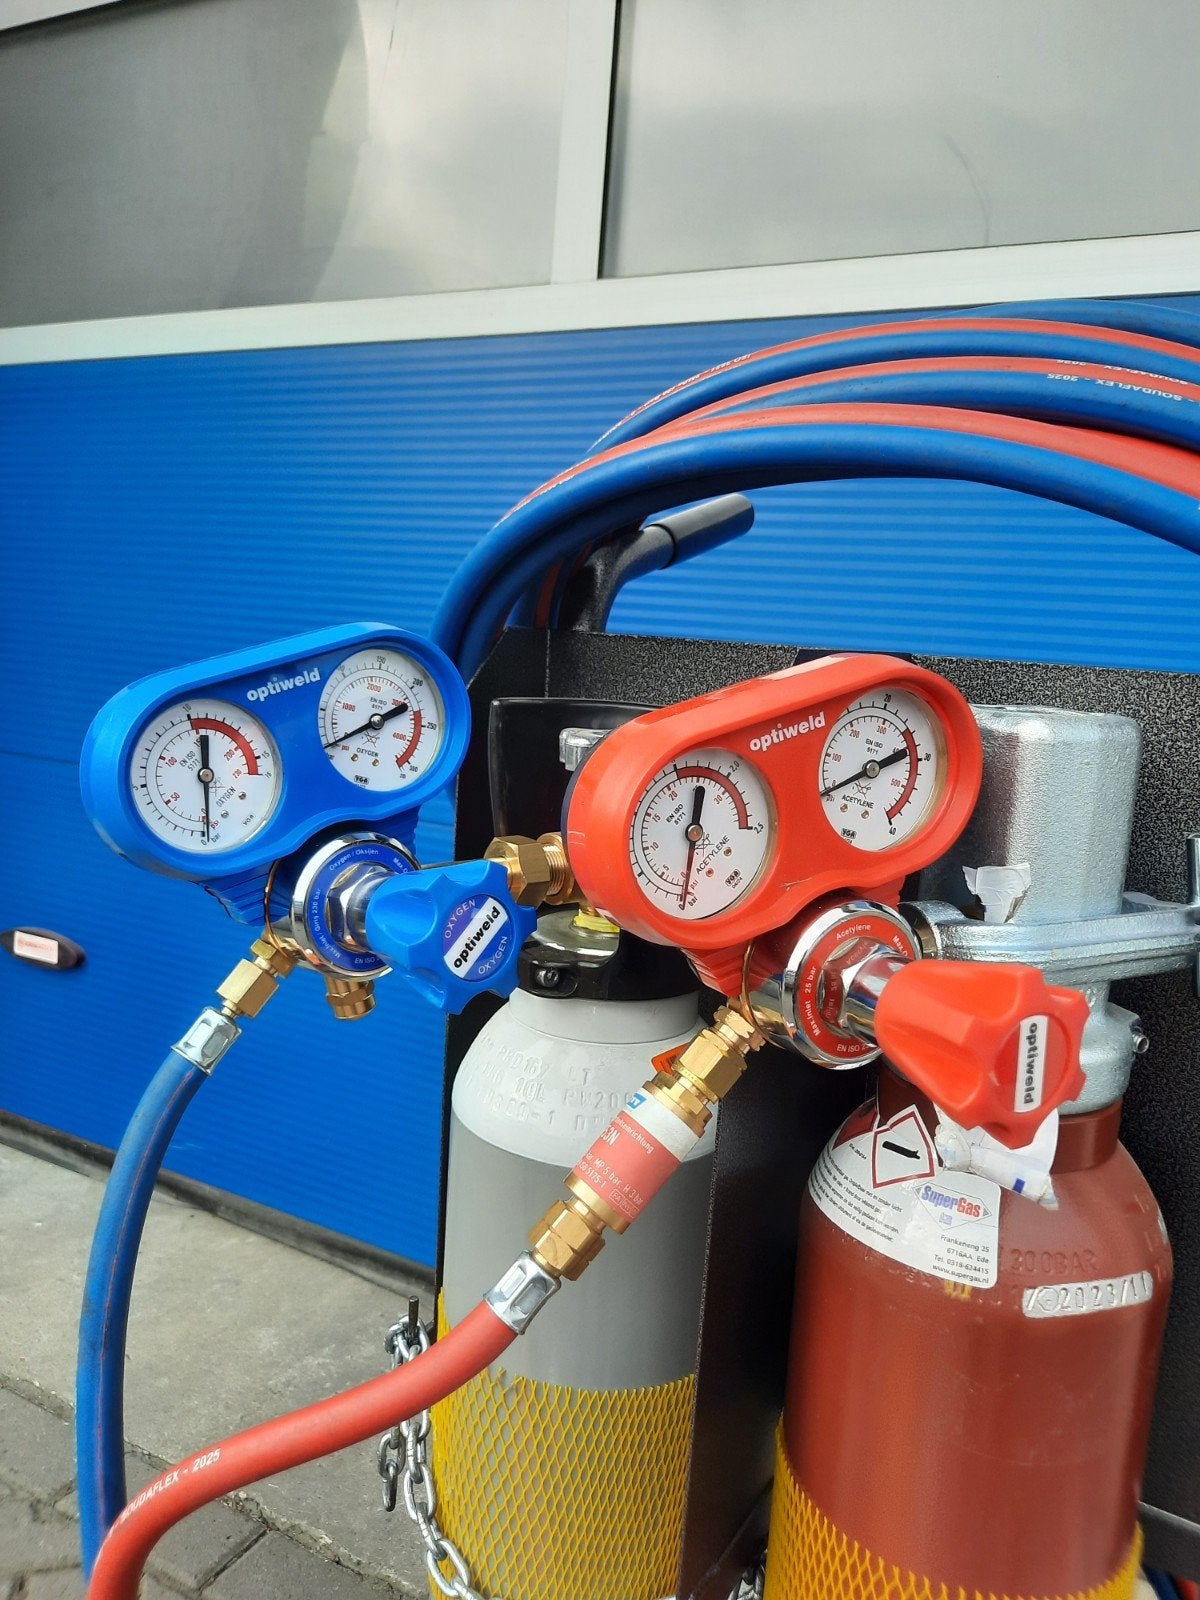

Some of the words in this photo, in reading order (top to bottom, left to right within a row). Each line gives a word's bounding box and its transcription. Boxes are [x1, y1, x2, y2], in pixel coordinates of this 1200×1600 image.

[1046, 373, 1079, 382] 2025
[1096, 379, 1184, 401] SOUDAFLEX
[247, 668, 320, 702] optiweld
[884, 694, 892, 702] 20
[182, 704, 192, 713] 10
[427, 722, 437, 730] 250
[750, 712, 826, 752] optiweld
[876, 725, 887, 735] 300
[850, 729, 860, 738] 200
[224, 750, 235, 762] 200
[356, 747, 379, 758] OXYGEN
[832, 753, 842, 762] 100
[924, 753, 932, 762] 30
[166, 756, 178, 768] 100
[179, 760, 188, 768] EN
[186, 750, 196, 762] ISO
[188, 760, 200, 772] 5171
[891, 778, 900, 787] 500
[170, 792, 180, 802] 50
[216, 786, 236, 808] OXYGEN
[669, 790, 678, 801] 20
[714, 794, 723, 805] 30
[842, 794, 874, 809] ACETYLENE
[652, 814, 661, 823] 15
[666, 813, 676, 823] EN
[673, 804, 684, 816] ISO
[674, 812, 686, 826] 5171
[210, 820, 219, 830] psi
[889, 826, 896, 836] 40
[211, 833, 221, 843] bar
[650, 842, 659, 852] 10
[696, 835, 730, 874] ACETYLENE
[329, 853, 352, 871] Oxygen
[663, 864, 670, 872] 5
[690, 880, 699, 890] psi
[688, 897, 698, 907] bar
[444, 899, 476, 938] OXYGEN
[454, 906, 500, 968] optiweld
[836, 924, 872, 941] Acetylene
[478, 936, 508, 974] OXYGEN
[806, 966, 816, 982] bar
[805, 983, 812, 994] 25
[837, 1044, 847, 1052] EN
[1024, 1022, 1039, 1104] optiweld
[586, 1167, 607, 1188] 5175-1
[603, 1167, 609, 1175] 5
[623, 1184, 631, 1194] H
[629, 1190, 635, 1199] 3
[921, 1185, 981, 1218] SuperGas
[940, 1234, 980, 1251] Frankeneng
[976, 1256, 989, 1264] Ede
[932, 1264, 989, 1284] www.supergas.nl
[192, 1448, 221, 1472] 2025
